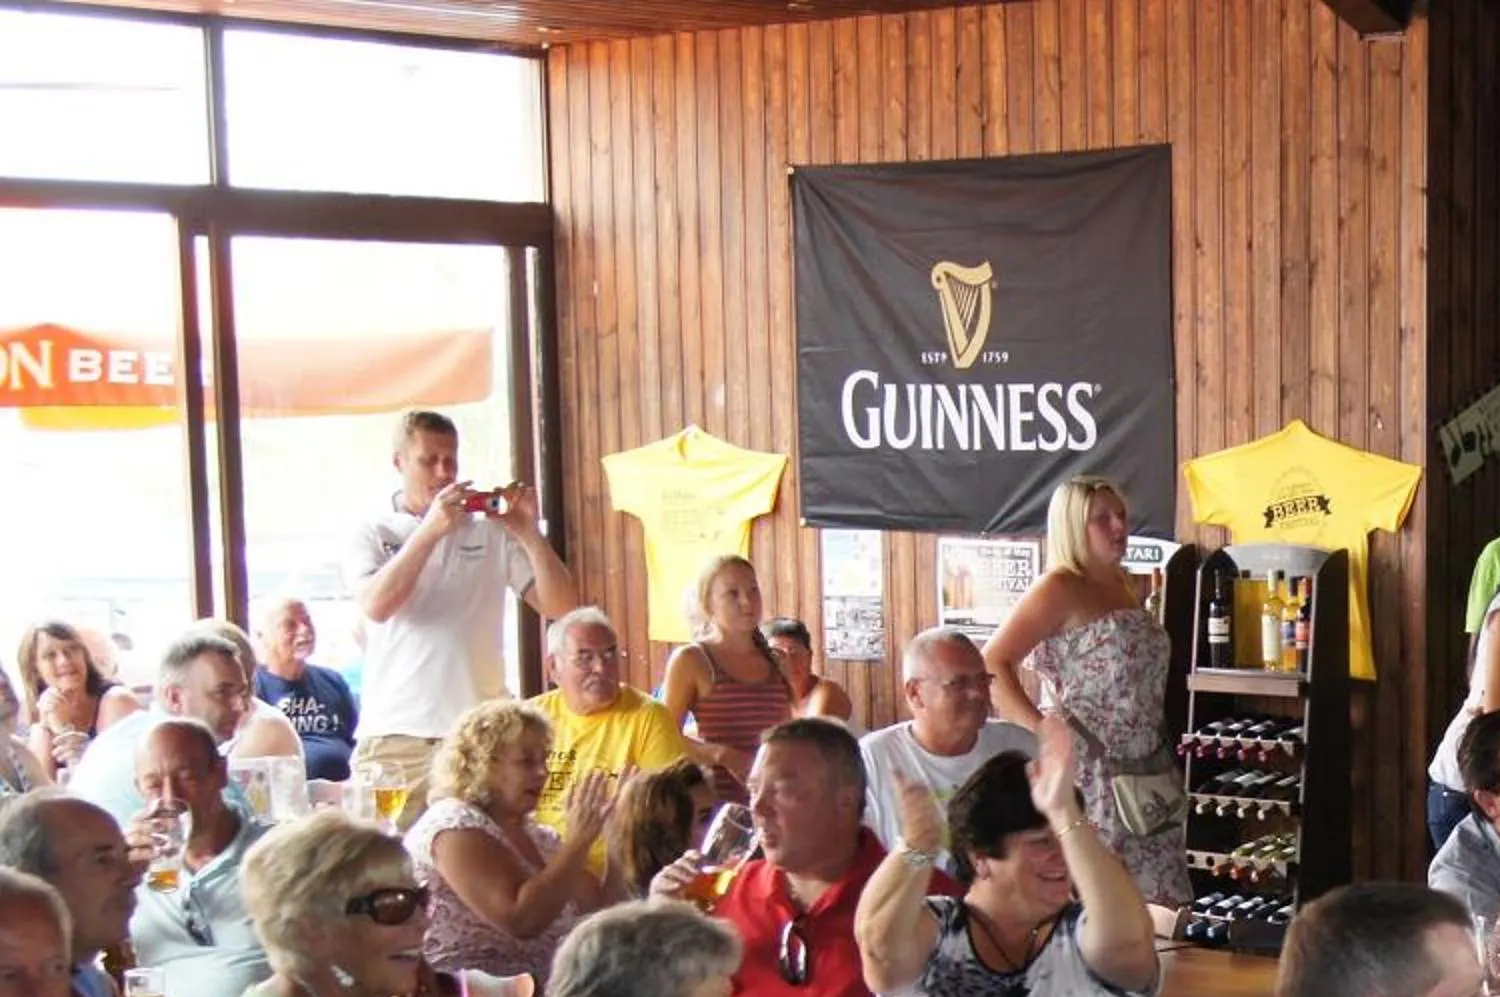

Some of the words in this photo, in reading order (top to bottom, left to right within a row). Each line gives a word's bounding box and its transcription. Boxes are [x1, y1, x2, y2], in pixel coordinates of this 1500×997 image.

[67, 347, 211, 388] BEE
[982, 351, 1009, 364] 1759
[841, 369, 1098, 452] GUINNESS
[1273, 496, 1321, 519] BEER
